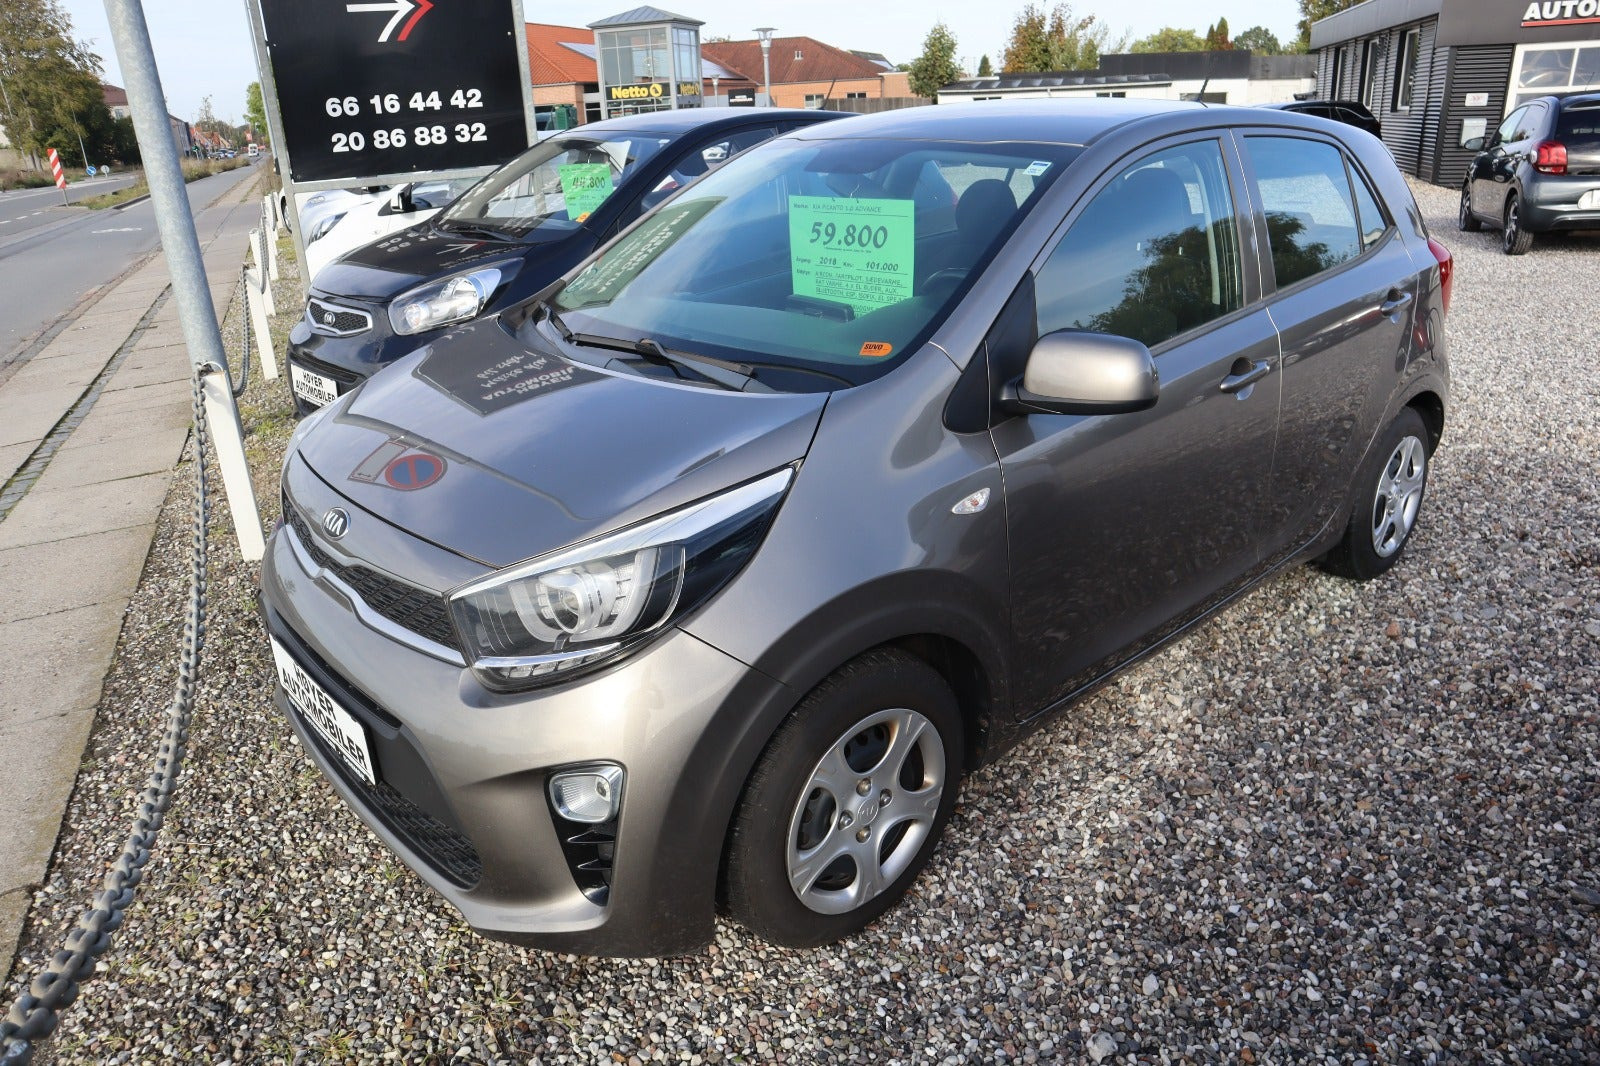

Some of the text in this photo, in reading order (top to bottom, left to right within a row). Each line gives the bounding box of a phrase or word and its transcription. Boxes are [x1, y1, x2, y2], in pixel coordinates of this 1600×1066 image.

[1522, 0, 1600, 20] AUTO
[325, 88, 484, 117] 66 16 44 42
[611, 85, 648, 99] Netto
[331, 122, 488, 153] 20 86 88 32
[822, 204, 844, 212] PICANTO
[809, 221, 888, 249] 59.800
[820, 256, 837, 266] 2018
[866, 261, 899, 271] 101.000
[324, 511, 344, 536] KIA
[282, 668, 368, 770] AUTOMOBILER
